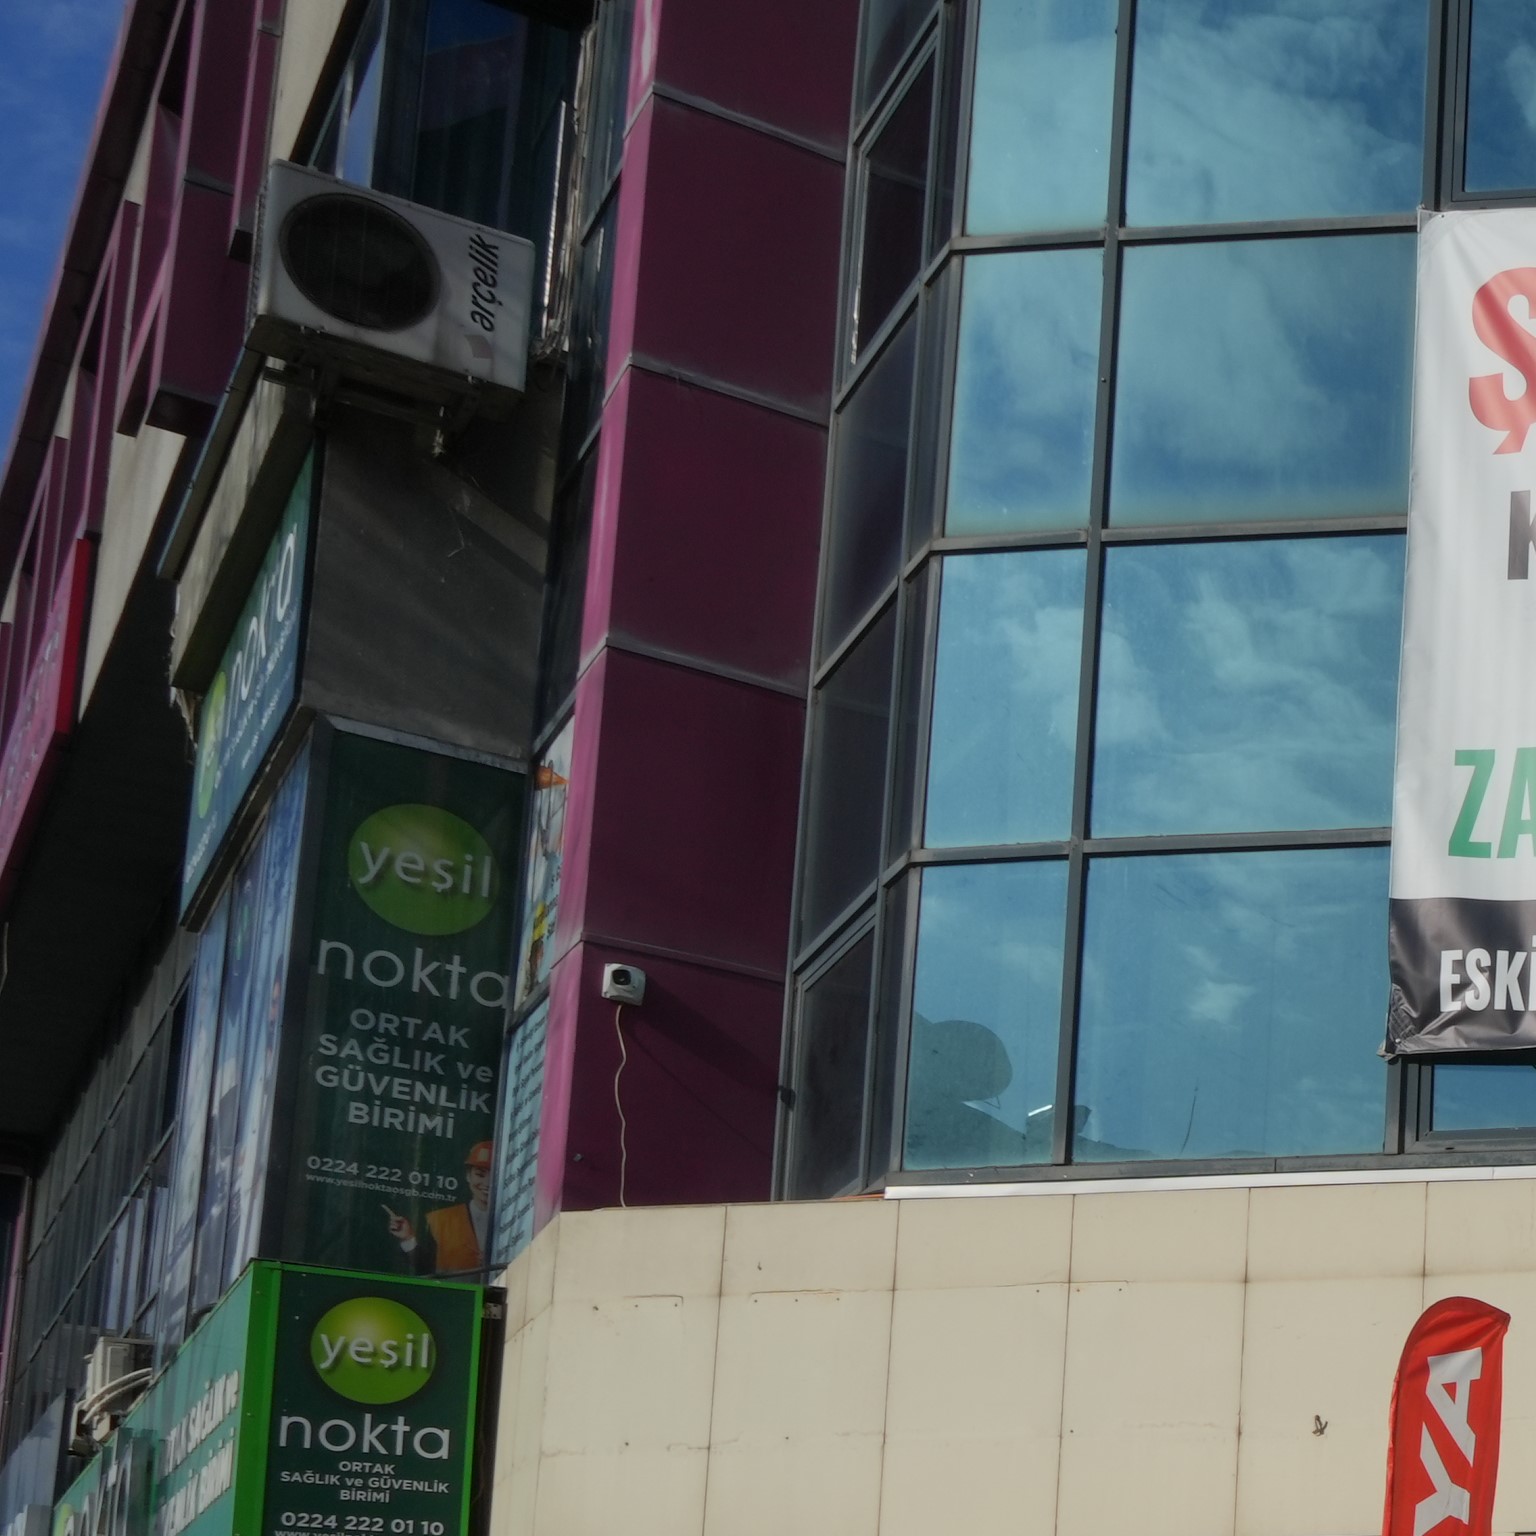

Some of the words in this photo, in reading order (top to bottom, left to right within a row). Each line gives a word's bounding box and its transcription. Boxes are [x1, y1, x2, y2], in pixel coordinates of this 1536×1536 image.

[468, 233, 504, 332] arçelik
[357, 838, 493, 898] yeşil
[316, 937, 509, 1009] nokta
[350, 1008, 471, 1049] ORTAK
[318, 1033, 446, 1075] SAĞLIK
[456, 1061, 494, 1083] ve
[315, 1065, 492, 1114] GÜVENLİK
[348, 1100, 455, 1139] BİRİMİ
[306, 1155, 360, 1176] 0224
[366, 1164, 402, 1182] 222
[408, 1169, 430, 1186] 01
[436, 1175, 458, 1190] 10
[319, 1332, 430, 1370] yeşil
[278, 1413, 451, 1460] nokta
[280, 1469, 341, 1487] SAĞLIK
[345, 1476, 364, 1488] ve
[368, 1473, 450, 1494] GÜVENLİK
[338, 1460, 397, 1476] ORTAK
[339, 1487, 390, 1503] BİRİMİ
[280, 1511, 338, 1530] 0224
[344, 1514, 384, 1532] 222
[391, 1518, 414, 1534] 01
[421, 1519, 445, 1536] 10
